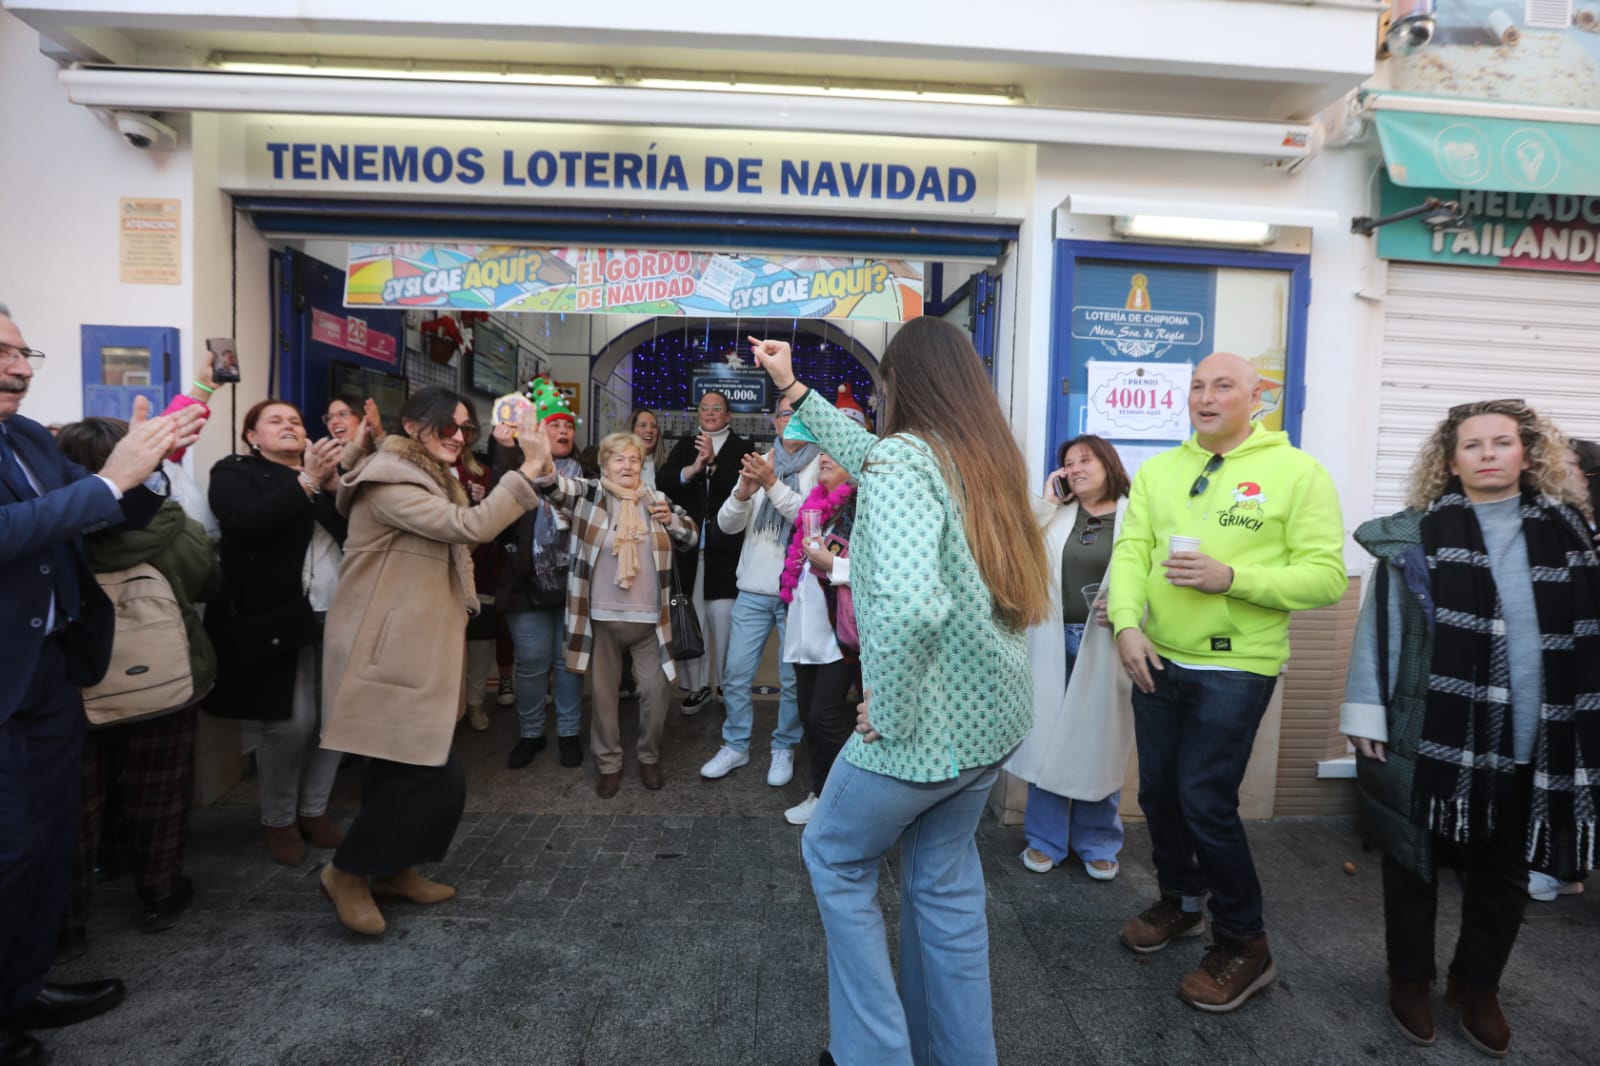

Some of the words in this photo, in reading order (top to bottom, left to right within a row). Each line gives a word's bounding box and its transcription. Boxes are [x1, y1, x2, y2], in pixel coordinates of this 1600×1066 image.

[267, 143, 486, 185] TENEMOS
[503, 142, 689, 191] LOTERÍA
[704, 156, 763, 196] DE
[781, 159, 977, 203] NAVIDAD
[422, 268, 463, 295] CAE
[463, 250, 542, 289] AQUÍ?
[578, 262, 602, 285] EL
[606, 250, 691, 281] GORDO
[770, 277, 809, 304] CAE
[810, 261, 889, 299] AQUÍ?
[577, 288, 602, 309] DE
[607, 277, 695, 305] NAVIDAD
[348, 318, 367, 343] 26
[1085, 311, 1127, 322] LOTERÍA
[1128, 314, 1142, 322] DE
[1143, 315, 1189, 326] CHIPIONA
[1105, 387, 1174, 409] 40014
[1218, 512, 1263, 532] GRINCH
